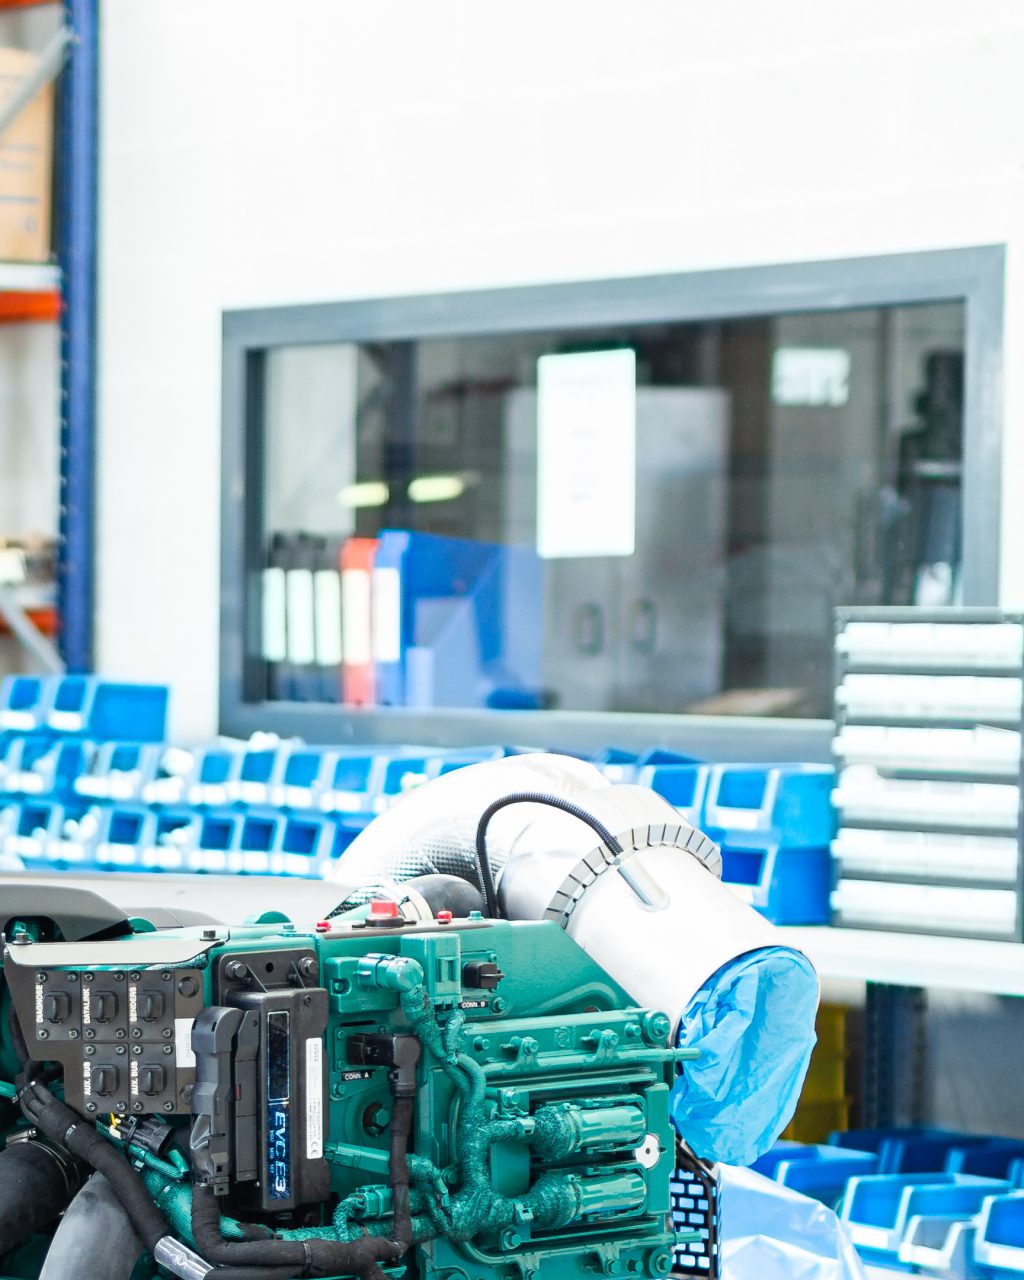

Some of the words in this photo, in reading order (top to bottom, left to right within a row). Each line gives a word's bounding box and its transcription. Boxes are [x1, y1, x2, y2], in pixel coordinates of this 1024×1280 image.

[35, 984, 44, 1023] DIAGNOSE
[82, 987, 91, 1024] DATALINK
[129, 986, 138, 1022] SENDERS
[83, 1061, 91, 1073] BUS
[130, 1060, 139, 1073] BUS
[275, 1111, 286, 1157] EVC
[275, 1160, 286, 1192] E3
